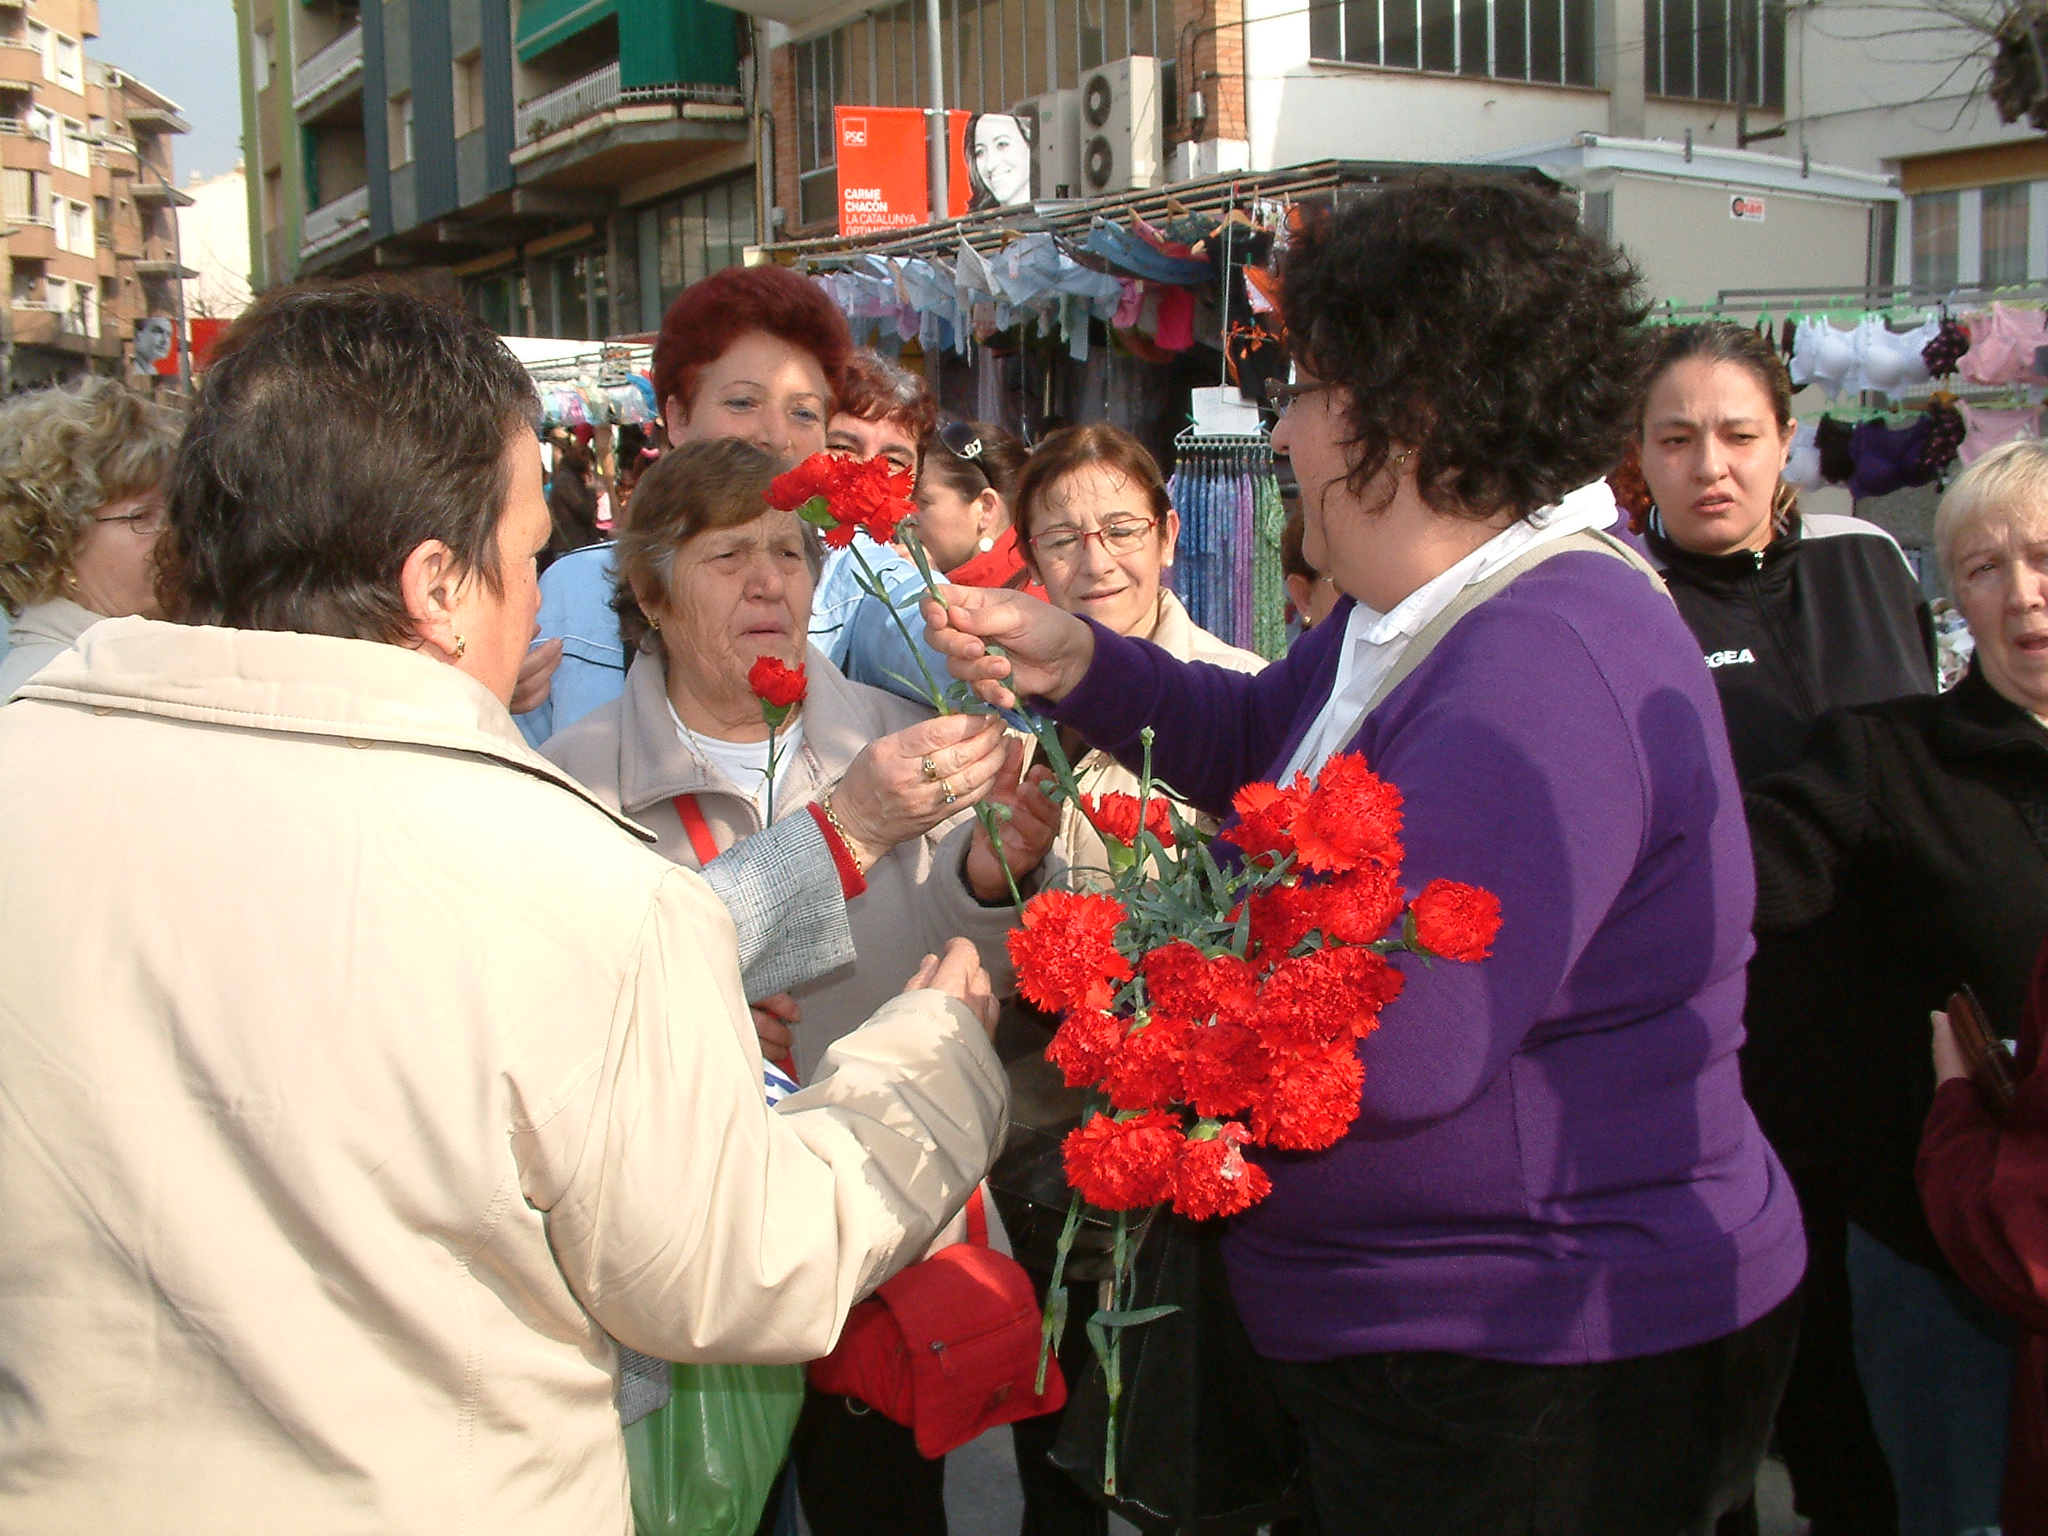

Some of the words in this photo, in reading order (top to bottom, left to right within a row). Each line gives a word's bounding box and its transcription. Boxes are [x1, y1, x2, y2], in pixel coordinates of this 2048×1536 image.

[845, 131, 864, 143] PSC
[844, 188, 881, 200] CARME
[845, 200, 888, 213] CHACÓN
[845, 213, 858, 224] LA
[860, 213, 917, 225] CATALUNYA
